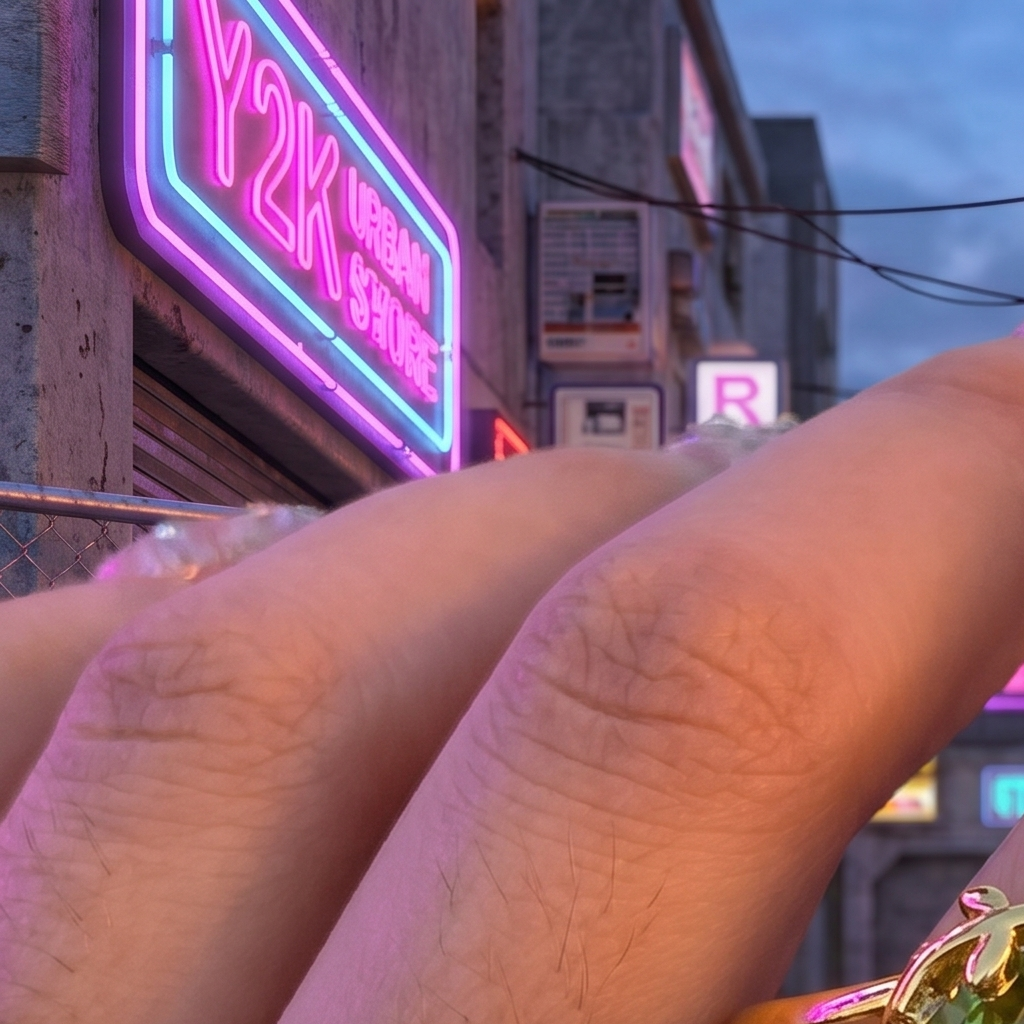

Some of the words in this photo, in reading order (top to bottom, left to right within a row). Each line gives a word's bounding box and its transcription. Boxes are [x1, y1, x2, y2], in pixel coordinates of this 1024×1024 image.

[188, 0, 343, 301] Y2K
[348, 166, 431, 315] URBAN
[715, 375, 761, 427] R
